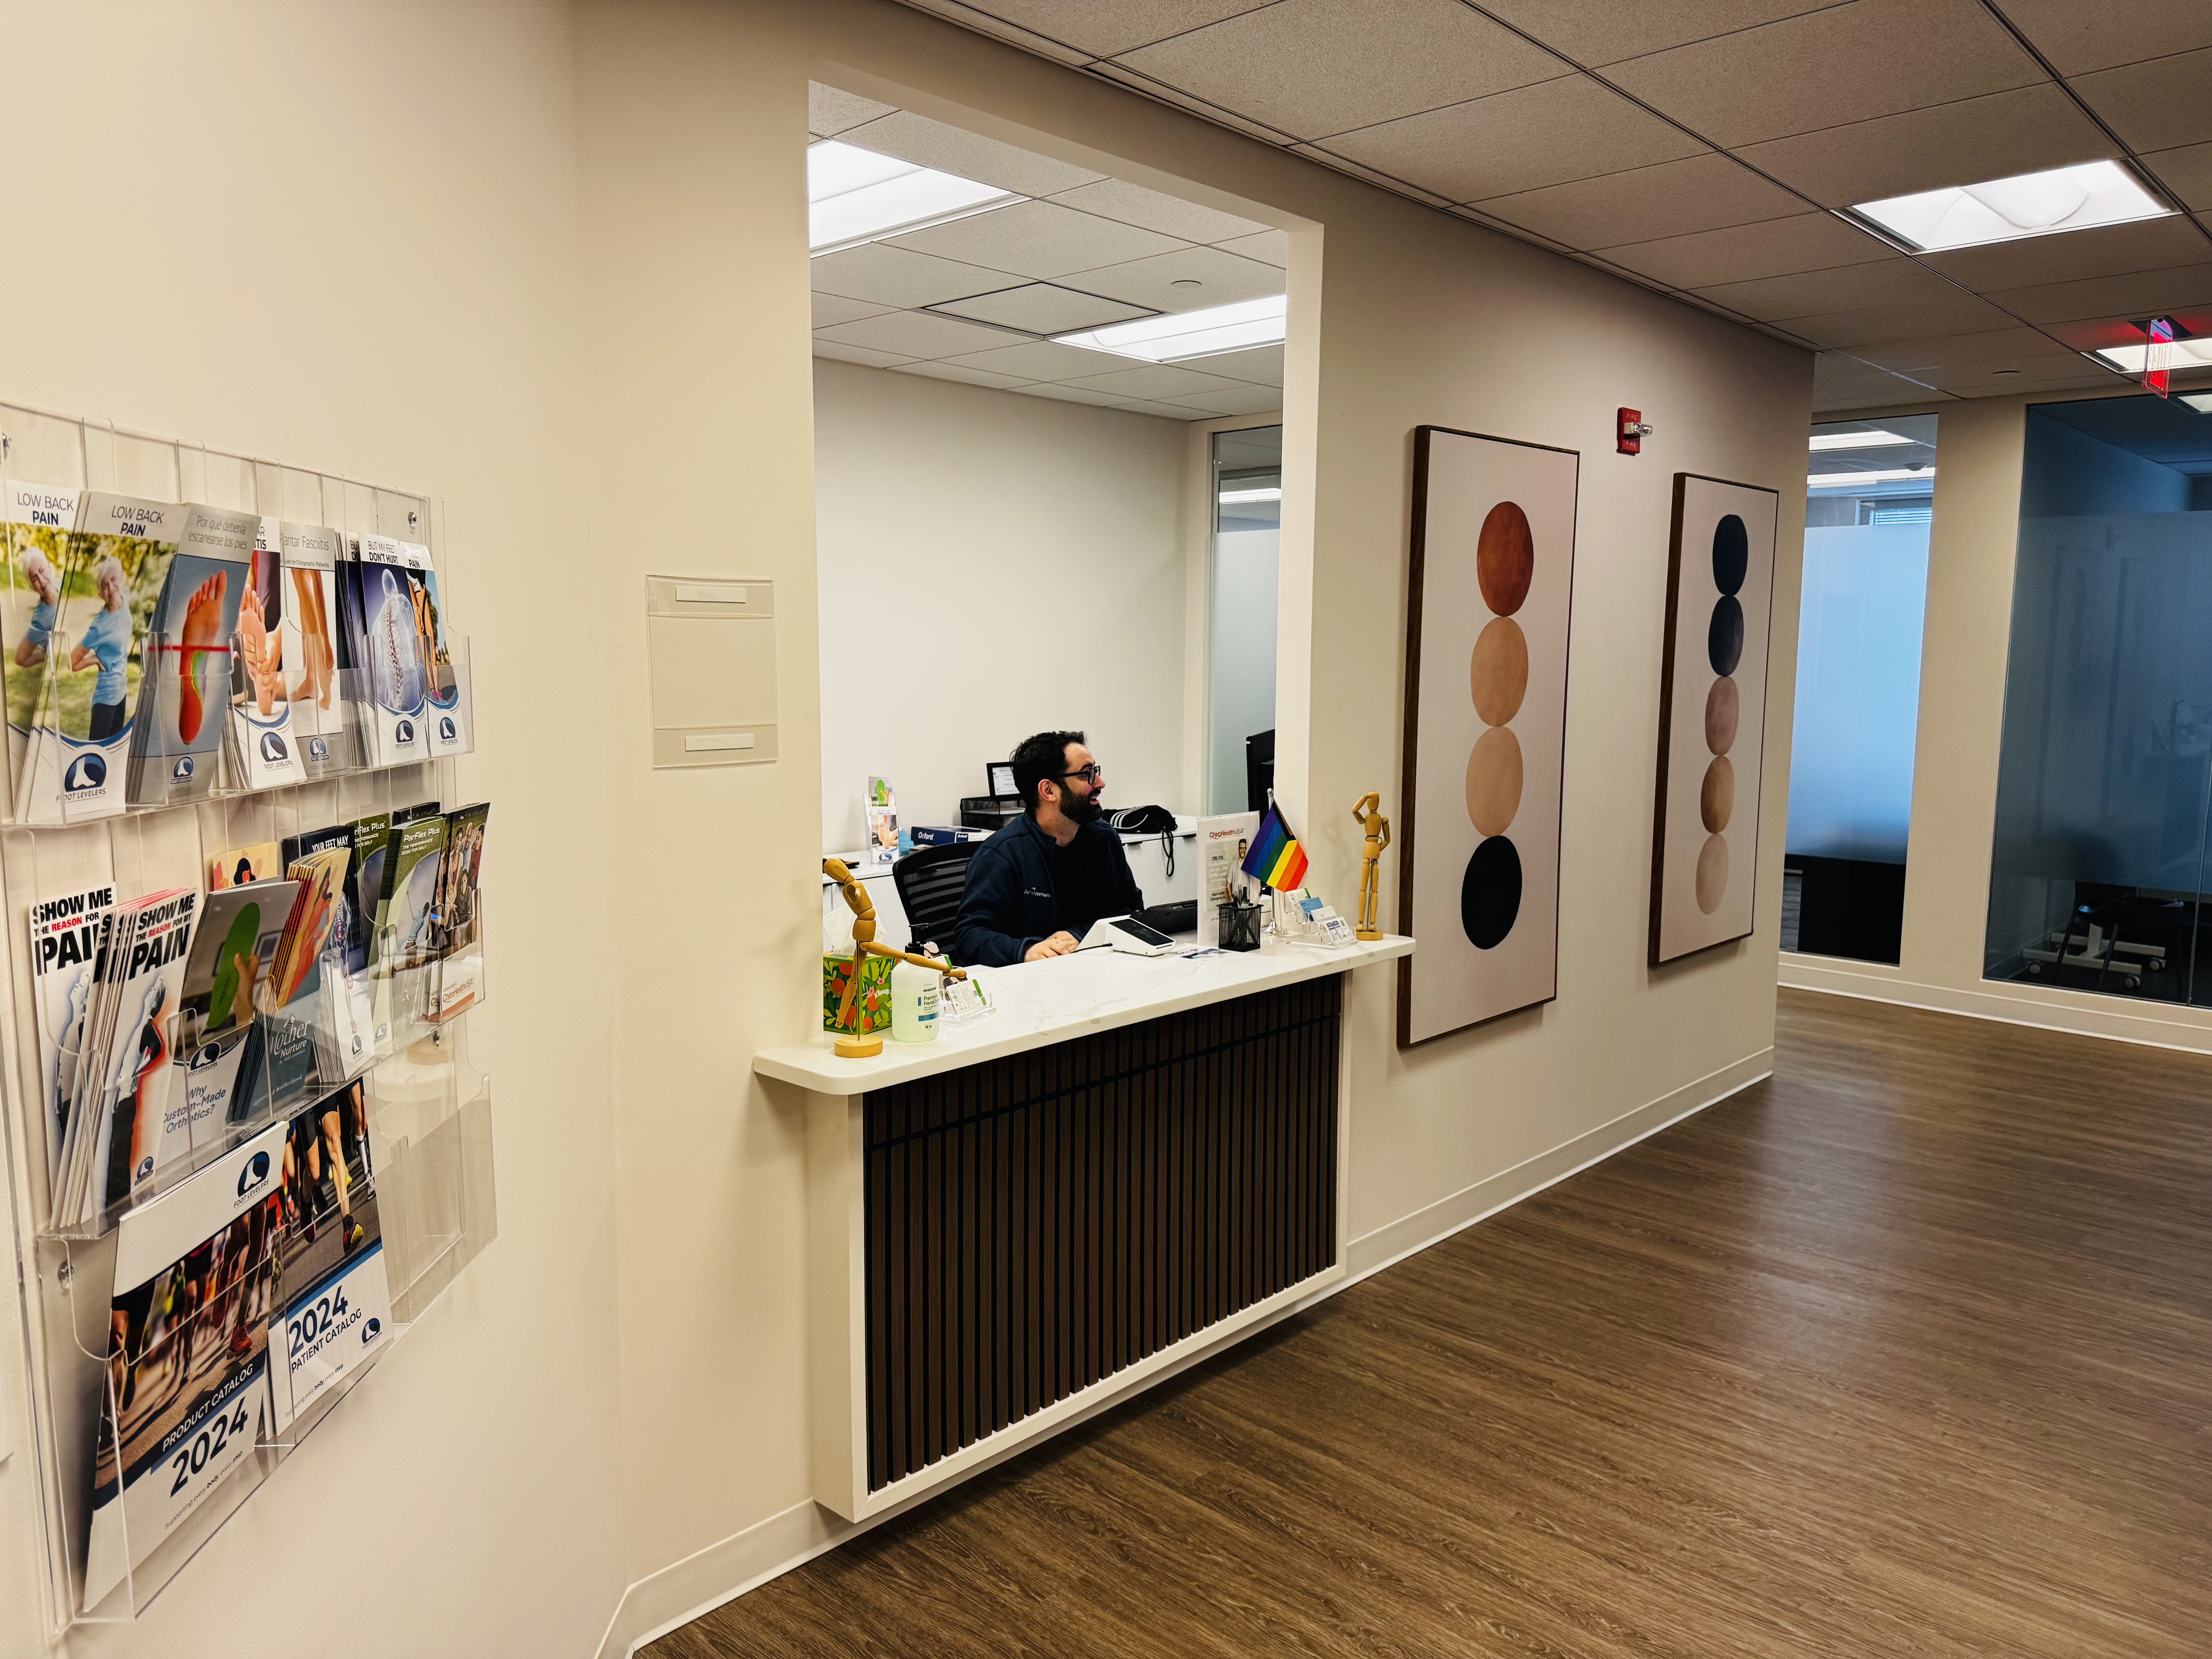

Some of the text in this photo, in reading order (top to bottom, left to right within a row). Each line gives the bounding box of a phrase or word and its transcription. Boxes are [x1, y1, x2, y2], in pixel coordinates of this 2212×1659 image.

[18, 492, 74, 512] LOW BACK
[33, 510, 59, 526] PAIN
[112, 505, 165, 524] LOW BACK
[120, 522, 146, 537] PAIN
[196, 515, 208, 527] Por
[209, 519, 222, 532] qué
[222, 520, 246, 534] debería
[188, 532, 224, 546] escanearse
[224, 536, 233, 548] los
[234, 539, 248, 551] pies
[302, 536, 329, 550] Fasciitis
[368, 541, 396, 554] BUT MY FEET
[369, 552, 385, 562] DON'T
[386, 555, 399, 565] HURT
[409, 559, 421, 568] PAIN
[77, 788, 106, 799] LEVELERS
[371, 821, 386, 831] Plus
[404, 828, 441, 842] ParFlex Plus
[312, 835, 349, 853] YOUR FEET MAY
[918, 831, 934, 841] Oxford
[33, 894, 85, 925] SHOW
[88, 887, 113, 910] ME
[138, 900, 178, 931] SHOW
[178, 893, 196, 915] ME
[34, 912, 99, 937] THE REASON FOR
[136, 932, 147, 943] THE
[148, 922, 171, 938] REASON
[173, 917, 183, 928] FOR
[183, 912, 192, 923] MY
[129, 923, 191, 981] PAIN
[281, 1040, 307, 1059] Nurture
[234, 1179, 269, 1208] FOOT LEVELERS
[289, 1285, 348, 1358] 2024
[292, 1309, 362, 1374] PATIENT CATALOG
[163, 1364, 253, 1452] PRODUCT CATALOG
[170, 1396, 248, 1498] 2024
